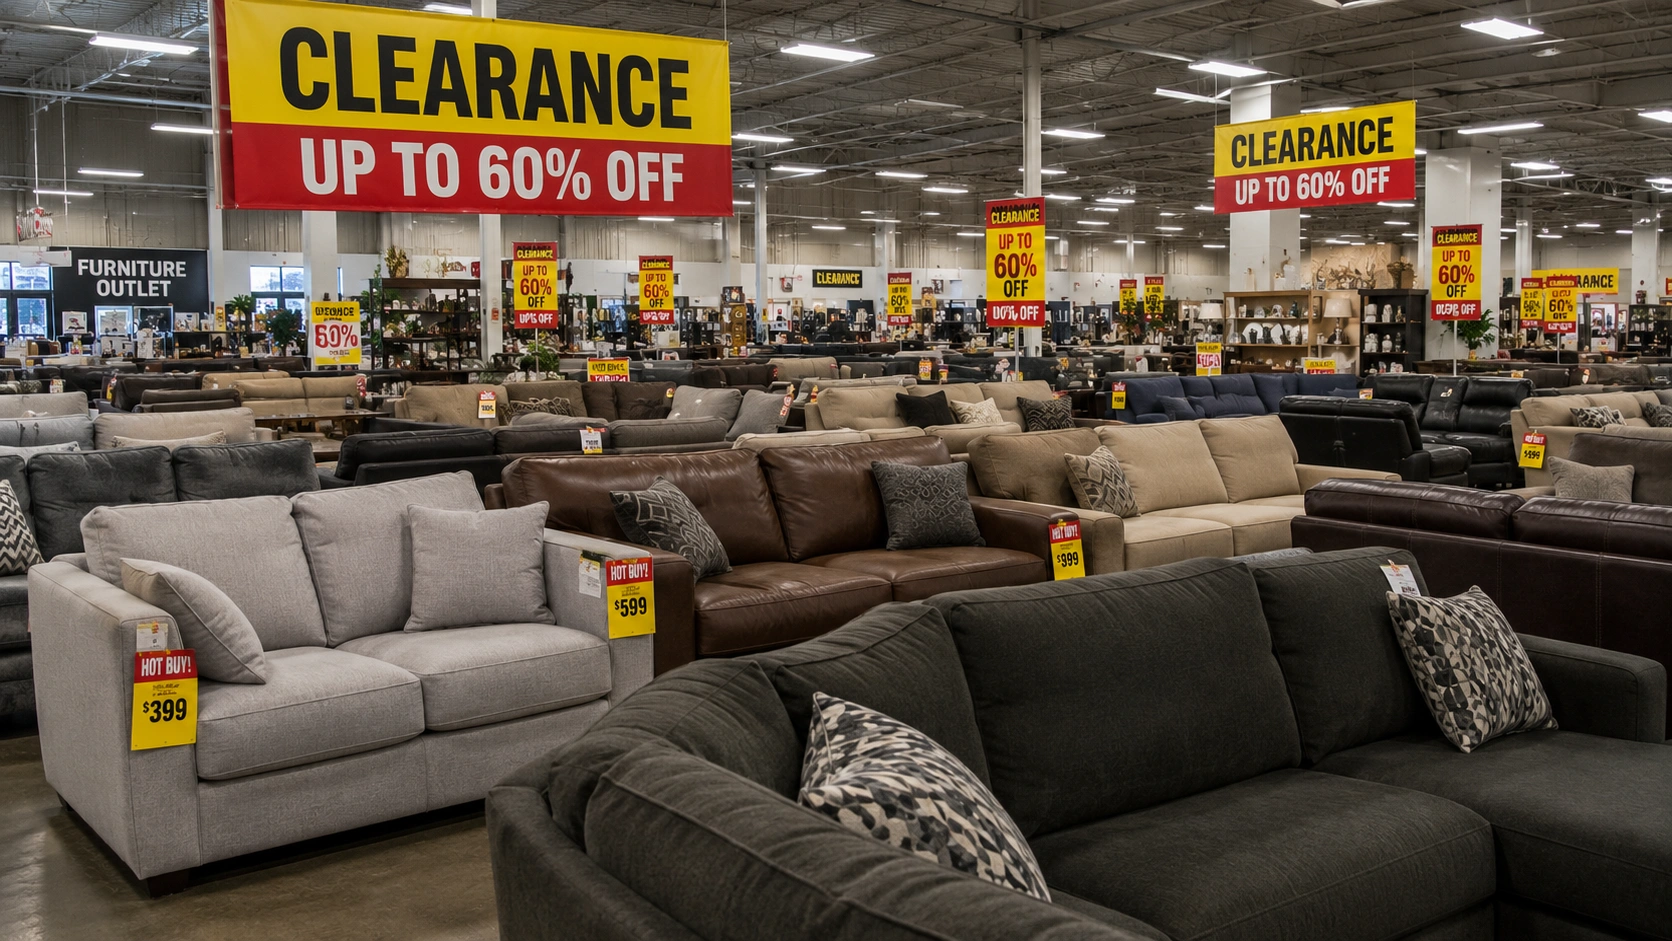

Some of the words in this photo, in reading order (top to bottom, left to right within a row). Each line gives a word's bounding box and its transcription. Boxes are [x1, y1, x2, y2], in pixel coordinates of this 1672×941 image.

[280, 26, 692, 129] CLEARANCE
[1231, 116, 1394, 169] CLEARANCE
[300, 138, 376, 195] UP
[391, 141, 460, 198] TO
[478, 145, 592, 201] 60%
[606, 150, 684, 202] OFF
[1235, 178, 1260, 205] UP
[1265, 175, 1290, 202] TO
[1296, 170, 1345, 200] 60%
[1352, 166, 1390, 196] OFF
[999, 233, 1014, 250] UP
[1017, 232, 1032, 249] TO
[1442, 250, 1455, 262] UP
[1458, 249, 1471, 262] TO
[77, 259, 187, 277] FURNITURE
[522, 265, 534, 276] UP
[537, 265, 547, 276] TO
[994, 252, 1037, 279] 60%
[1438, 264, 1475, 284] 60%
[96, 279, 171, 297] OUTLET
[520, 278, 552, 296] 60%
[644, 284, 669, 298] 60%
[1003, 280, 1028, 298] OFF
[1446, 284, 1467, 298] OFF
[527, 296, 545, 308] OFF
[649, 298, 664, 308] OFF
[538, 313, 553, 324] OFF
[1020, 305, 1039, 321] OFF
[1056, 551, 1079, 568] $999
[610, 564, 627, 581] HOT
[614, 596, 647, 618] $599
[141, 657, 163, 677] HOT
[165, 656, 191, 675] BUY!
[142, 698, 187, 723] $399
